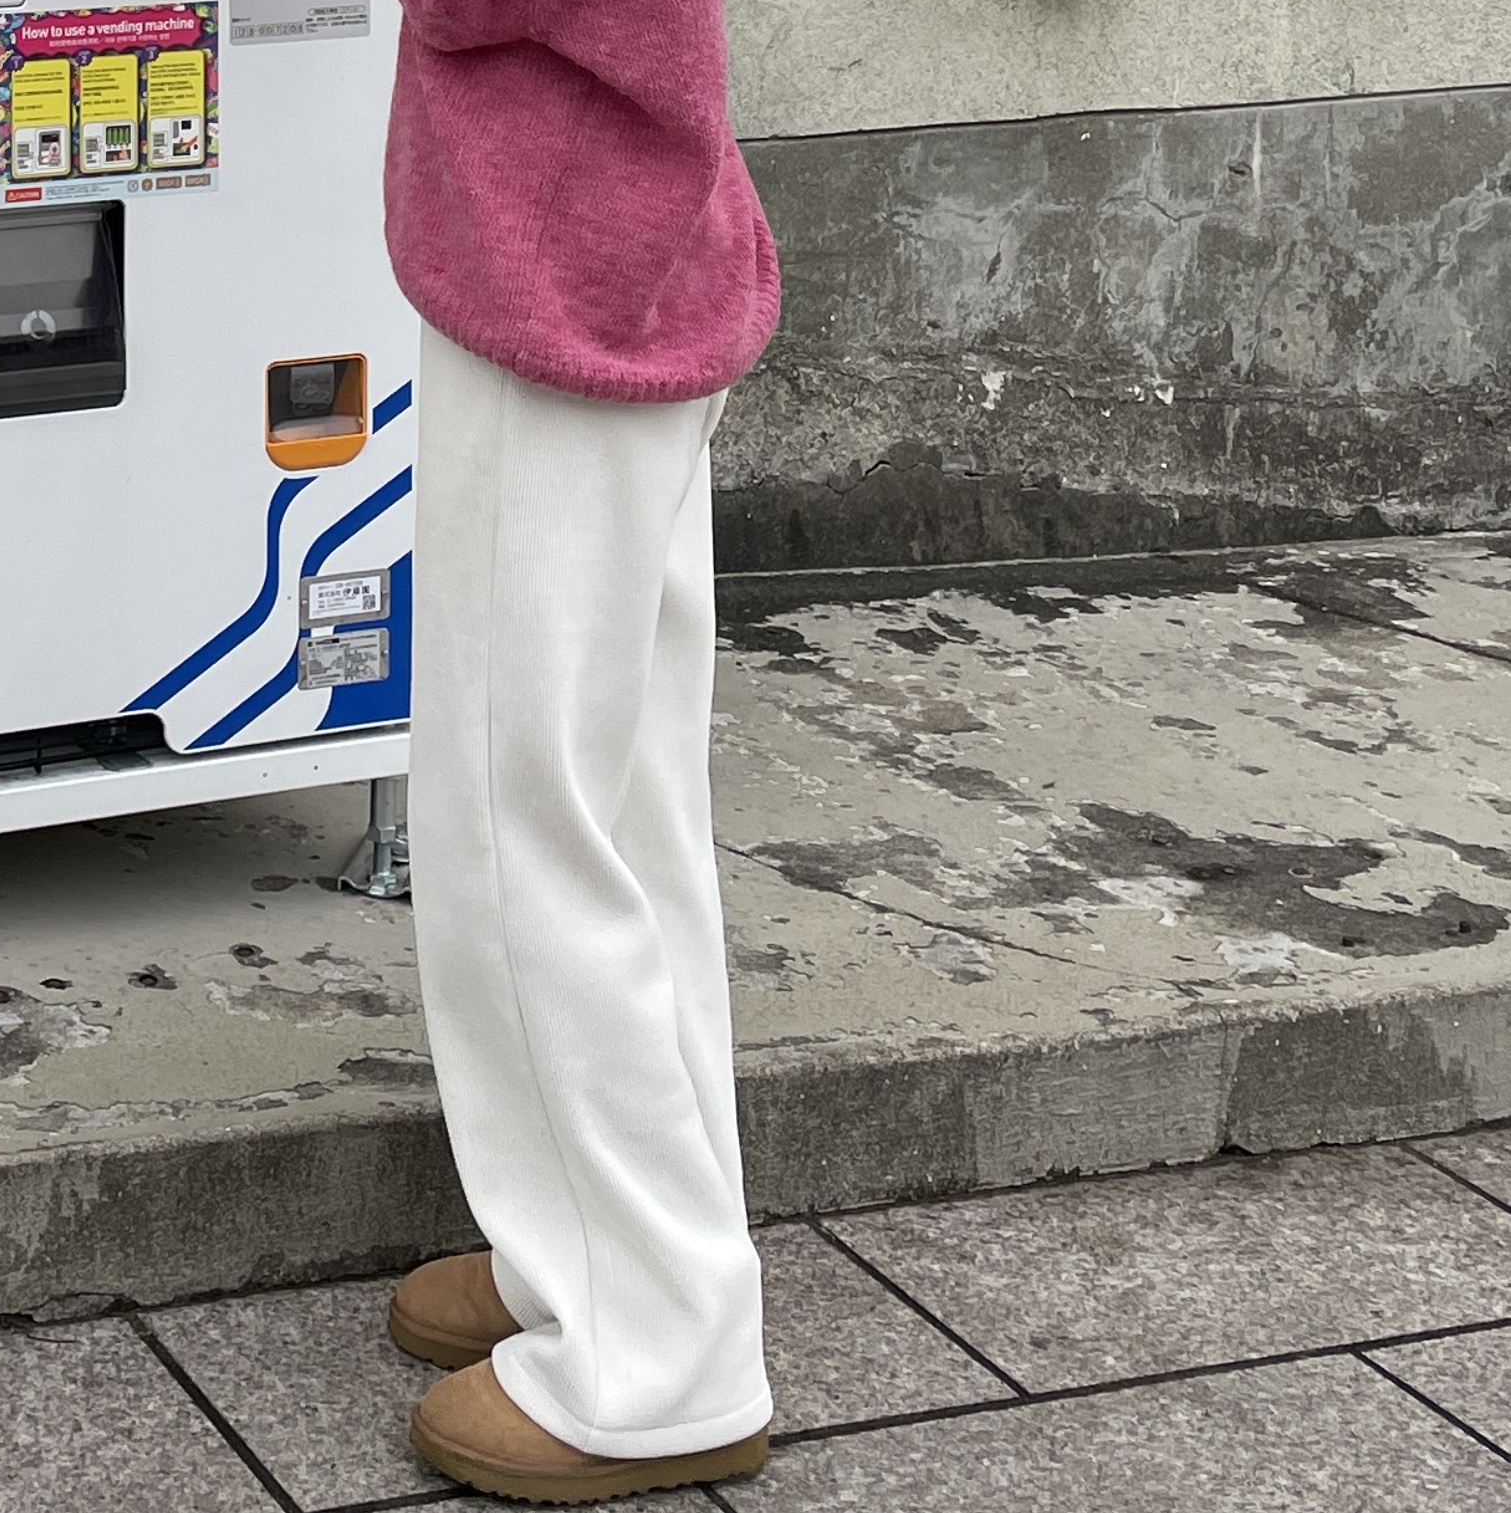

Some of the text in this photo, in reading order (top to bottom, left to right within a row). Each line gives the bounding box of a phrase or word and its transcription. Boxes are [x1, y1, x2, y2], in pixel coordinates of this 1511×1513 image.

[22, 18, 195, 44] How to use a vending machine
